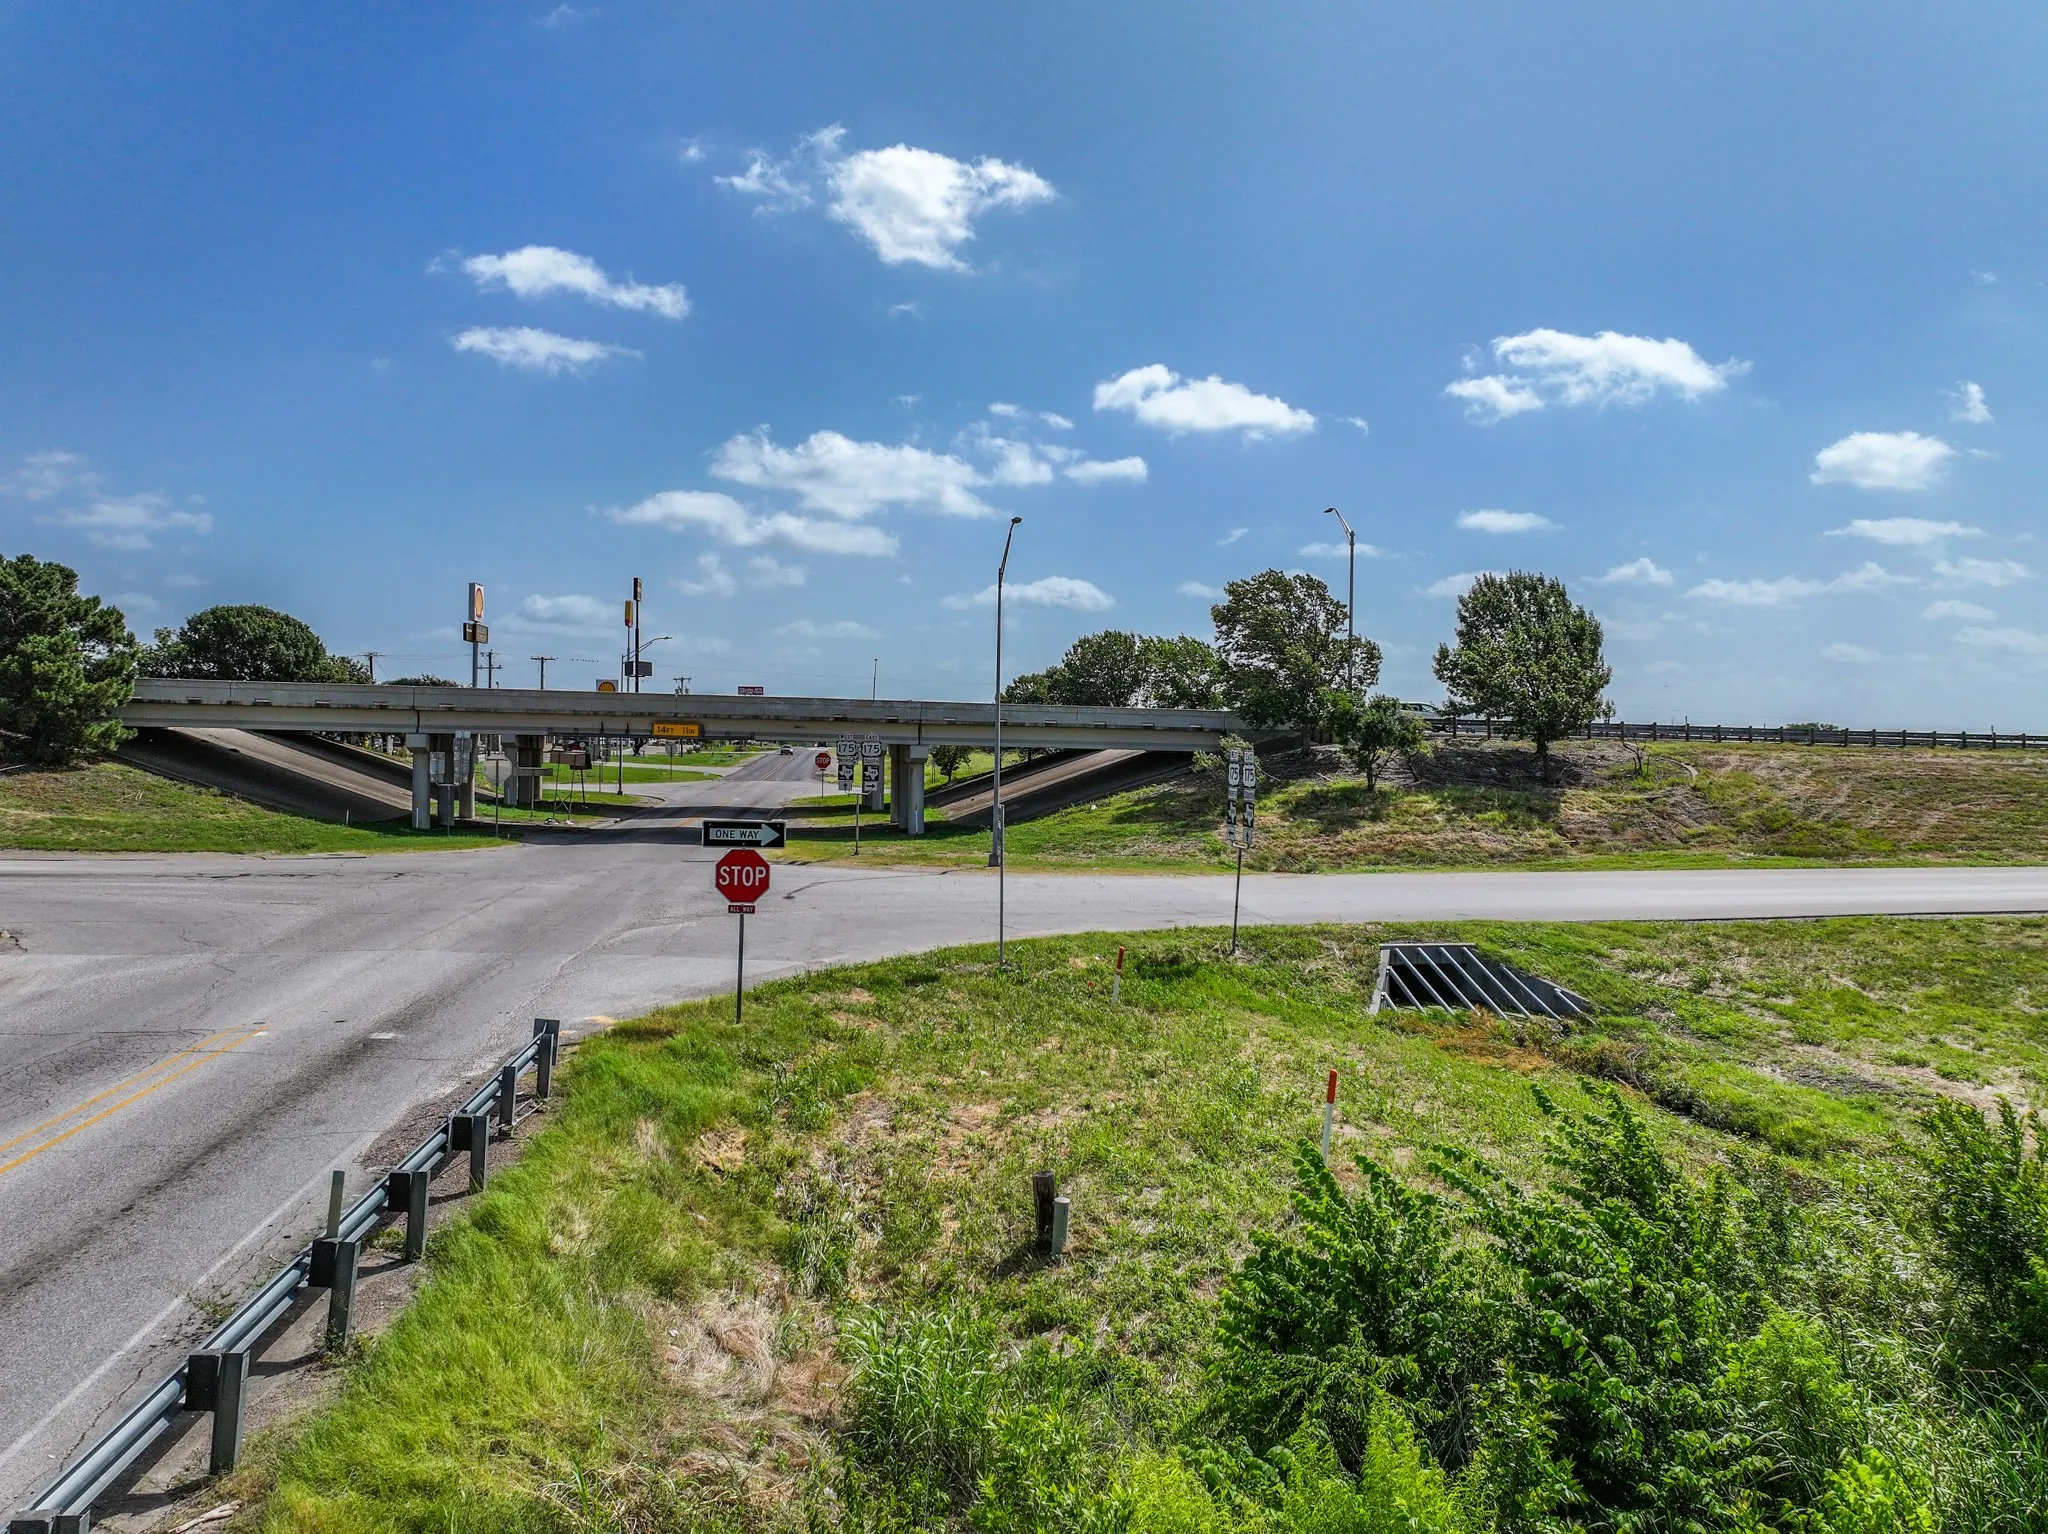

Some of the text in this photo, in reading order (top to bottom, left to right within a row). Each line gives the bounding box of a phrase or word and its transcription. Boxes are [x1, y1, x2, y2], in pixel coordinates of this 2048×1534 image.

[657, 725, 674, 734] 14FT
[838, 743, 855, 753] 175
[864, 744, 880, 754] 175
[1230, 767, 1239, 780] 175
[1244, 768, 1255, 782] 175
[715, 829, 760, 839] ONE WAY
[719, 865, 767, 887] STOP
